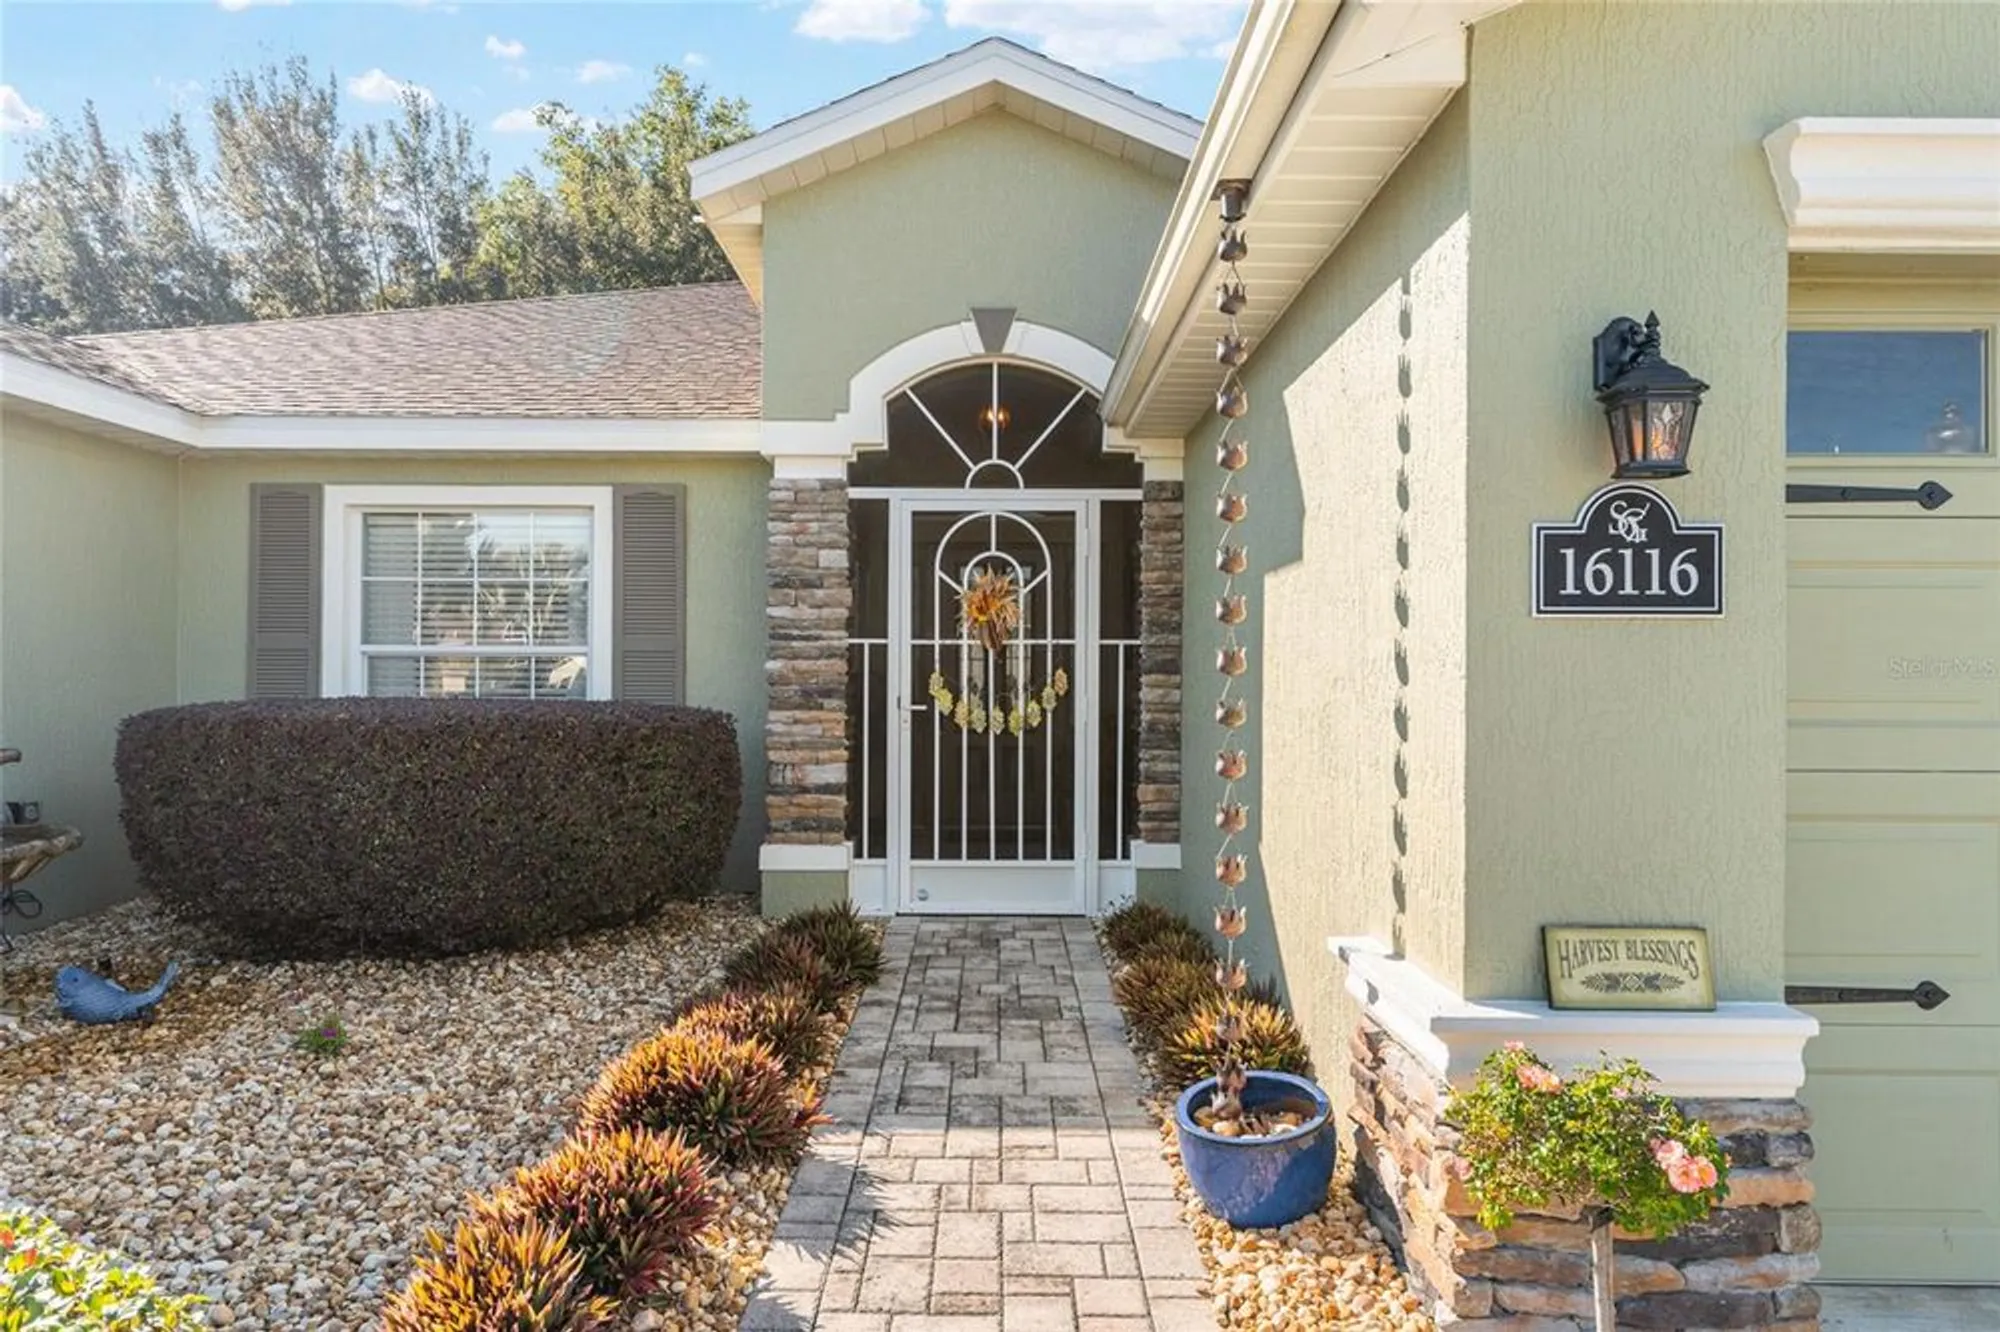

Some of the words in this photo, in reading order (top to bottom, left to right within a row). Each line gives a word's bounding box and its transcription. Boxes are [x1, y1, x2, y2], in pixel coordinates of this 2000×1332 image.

[1559, 548, 1699, 595] 16116
[1557, 939, 1619, 978] HARVEST
[1625, 939, 1699, 980] BLESSINGS
